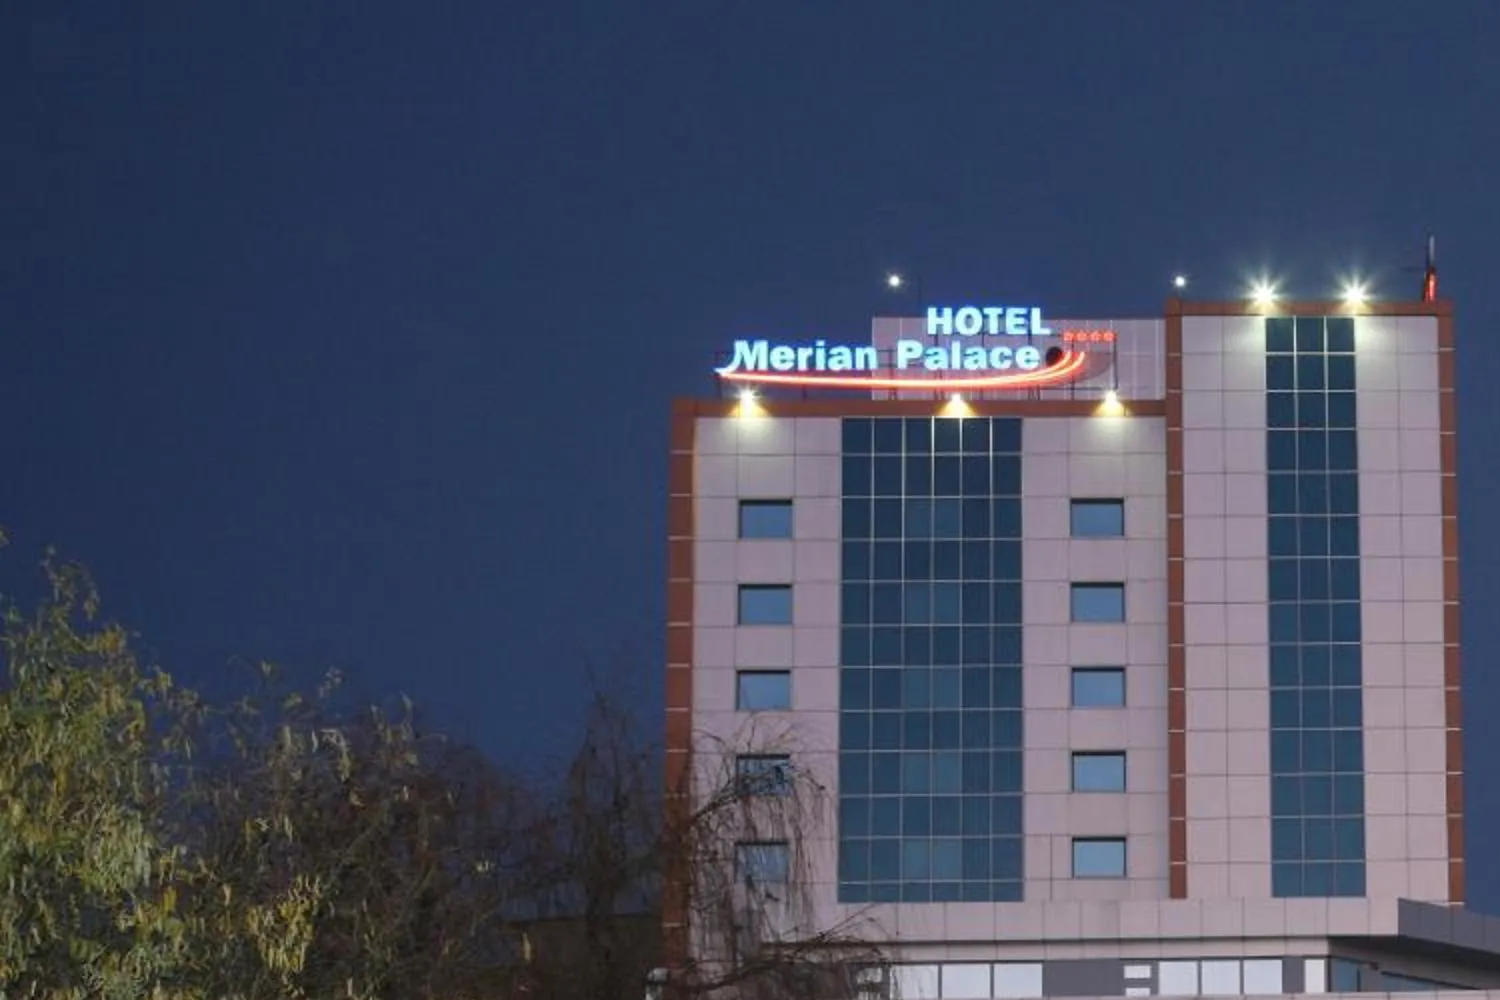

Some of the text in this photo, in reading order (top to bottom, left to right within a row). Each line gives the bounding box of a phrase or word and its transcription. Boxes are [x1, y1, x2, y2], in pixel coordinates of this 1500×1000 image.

[927, 307, 1051, 335] HOTEL
[713, 339, 1041, 374] Merian Palace
